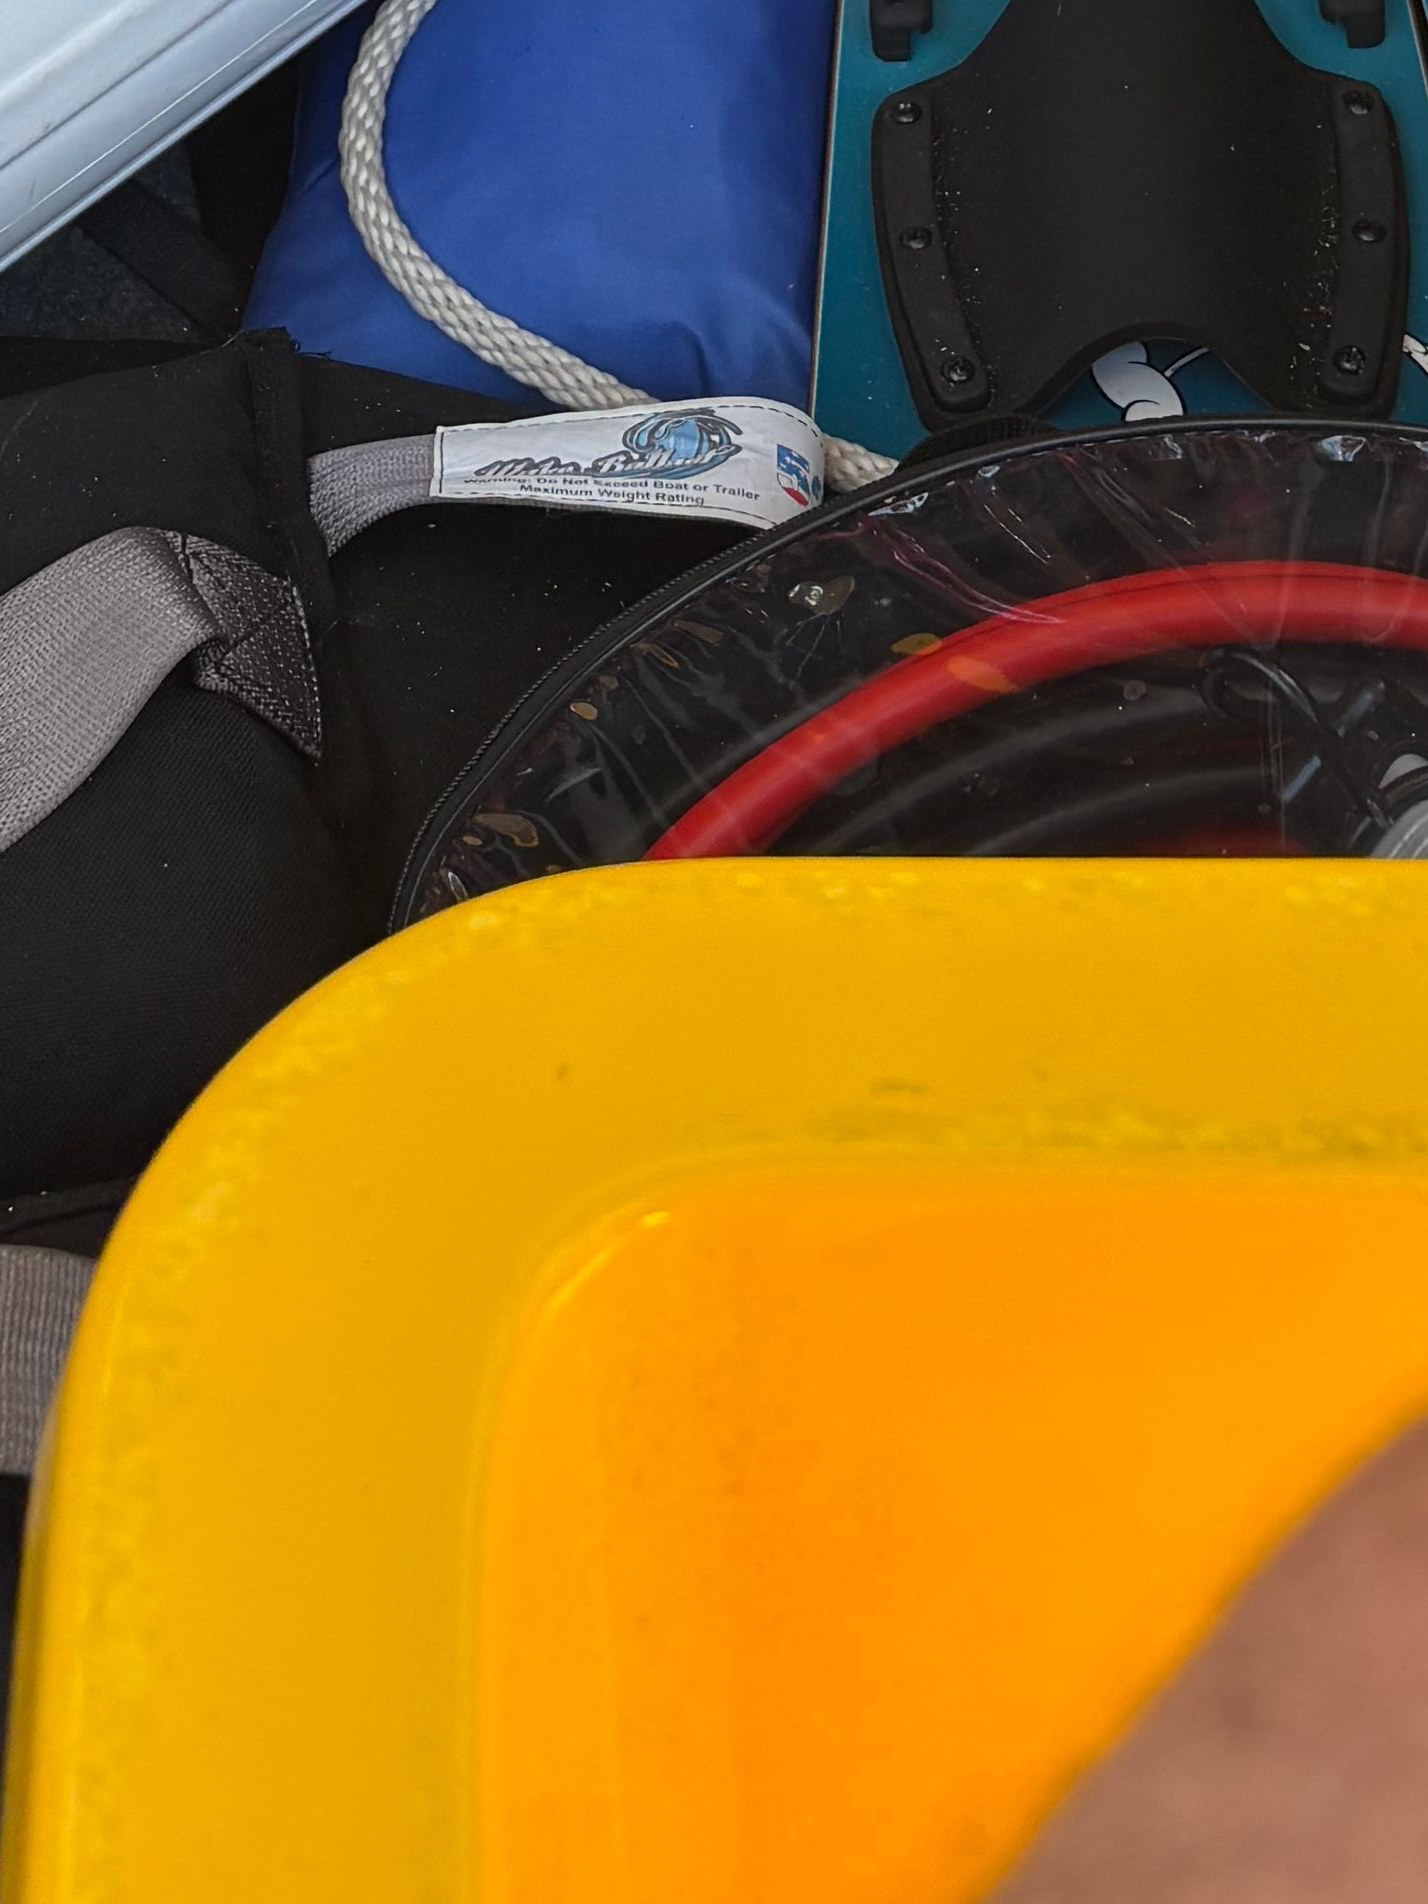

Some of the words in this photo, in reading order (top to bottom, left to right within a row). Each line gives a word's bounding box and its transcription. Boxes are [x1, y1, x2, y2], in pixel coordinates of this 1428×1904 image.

[520, 484, 593, 497] Maximum
[598, 488, 651, 502] Weight
[655, 492, 705, 506] Rating
[536, 477, 558, 486] Do
[562, 477, 588, 486] Not
[653, 480, 690, 490] Boat
[693, 483, 711, 492] or
[713, 484, 761, 500] Trailer
